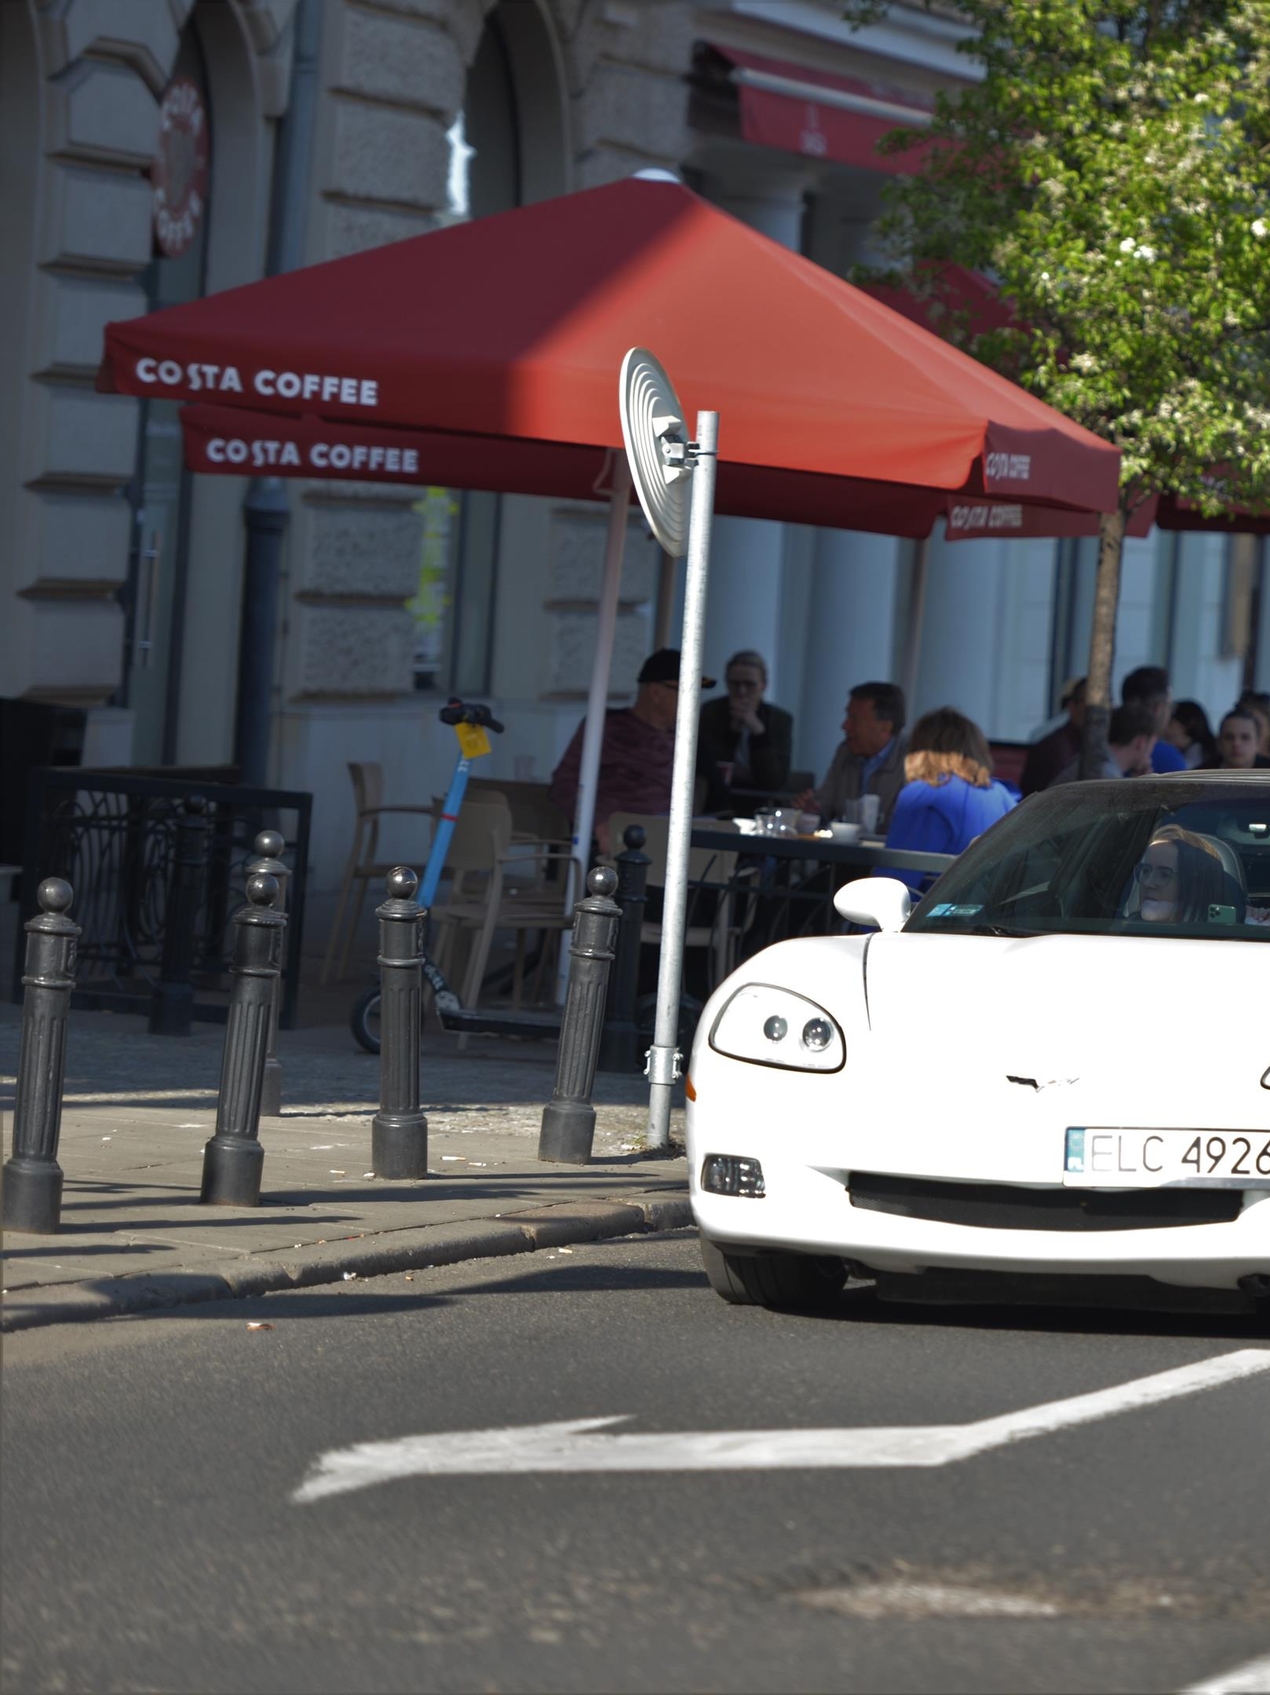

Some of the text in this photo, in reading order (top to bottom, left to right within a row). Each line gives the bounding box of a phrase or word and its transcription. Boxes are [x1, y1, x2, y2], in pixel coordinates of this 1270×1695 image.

[135, 357, 378, 406] COSTA COFFEE
[206, 438, 418, 473] COSTA COFFEE
[1091, 1135, 1164, 1173] ELC
